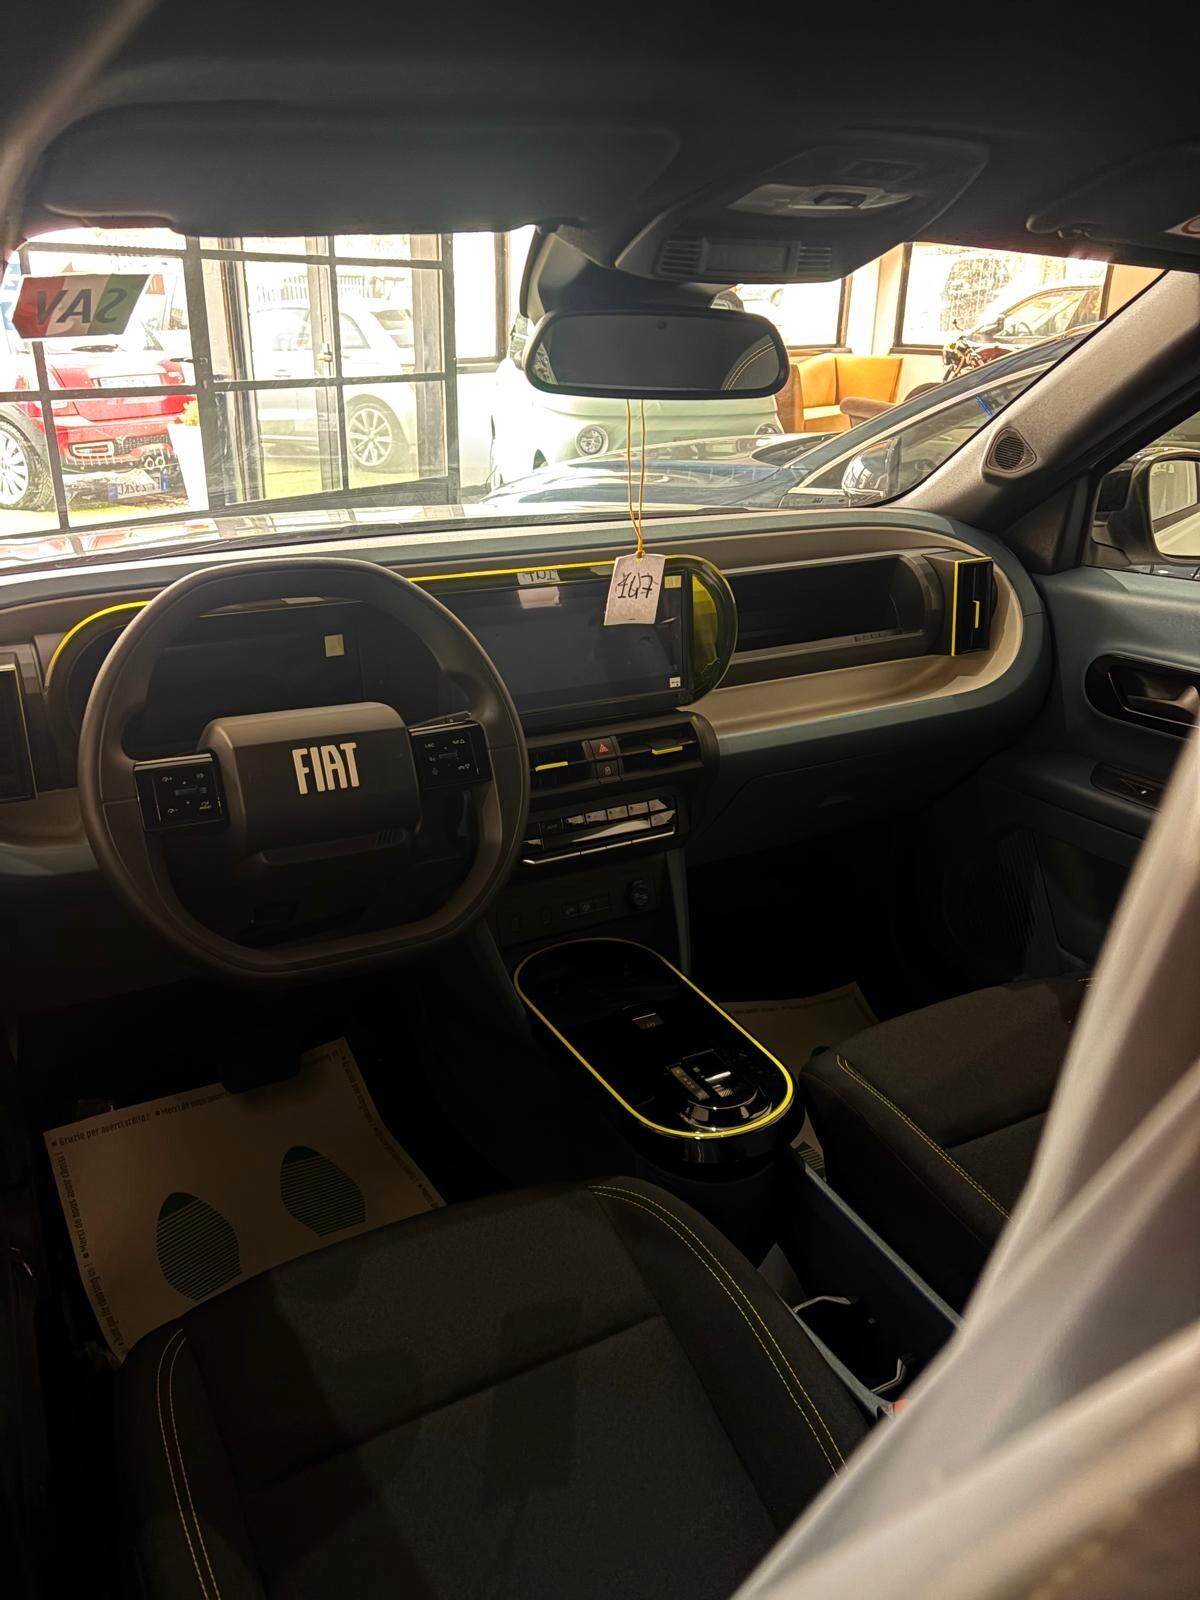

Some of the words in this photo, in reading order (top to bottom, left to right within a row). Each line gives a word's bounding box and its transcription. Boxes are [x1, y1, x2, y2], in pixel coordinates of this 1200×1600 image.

[617, 572, 657, 600] 147
[291, 742, 361, 795] FIAT
[58, 1131, 85, 1146] Grazie
[86, 1127, 99, 1140] per
